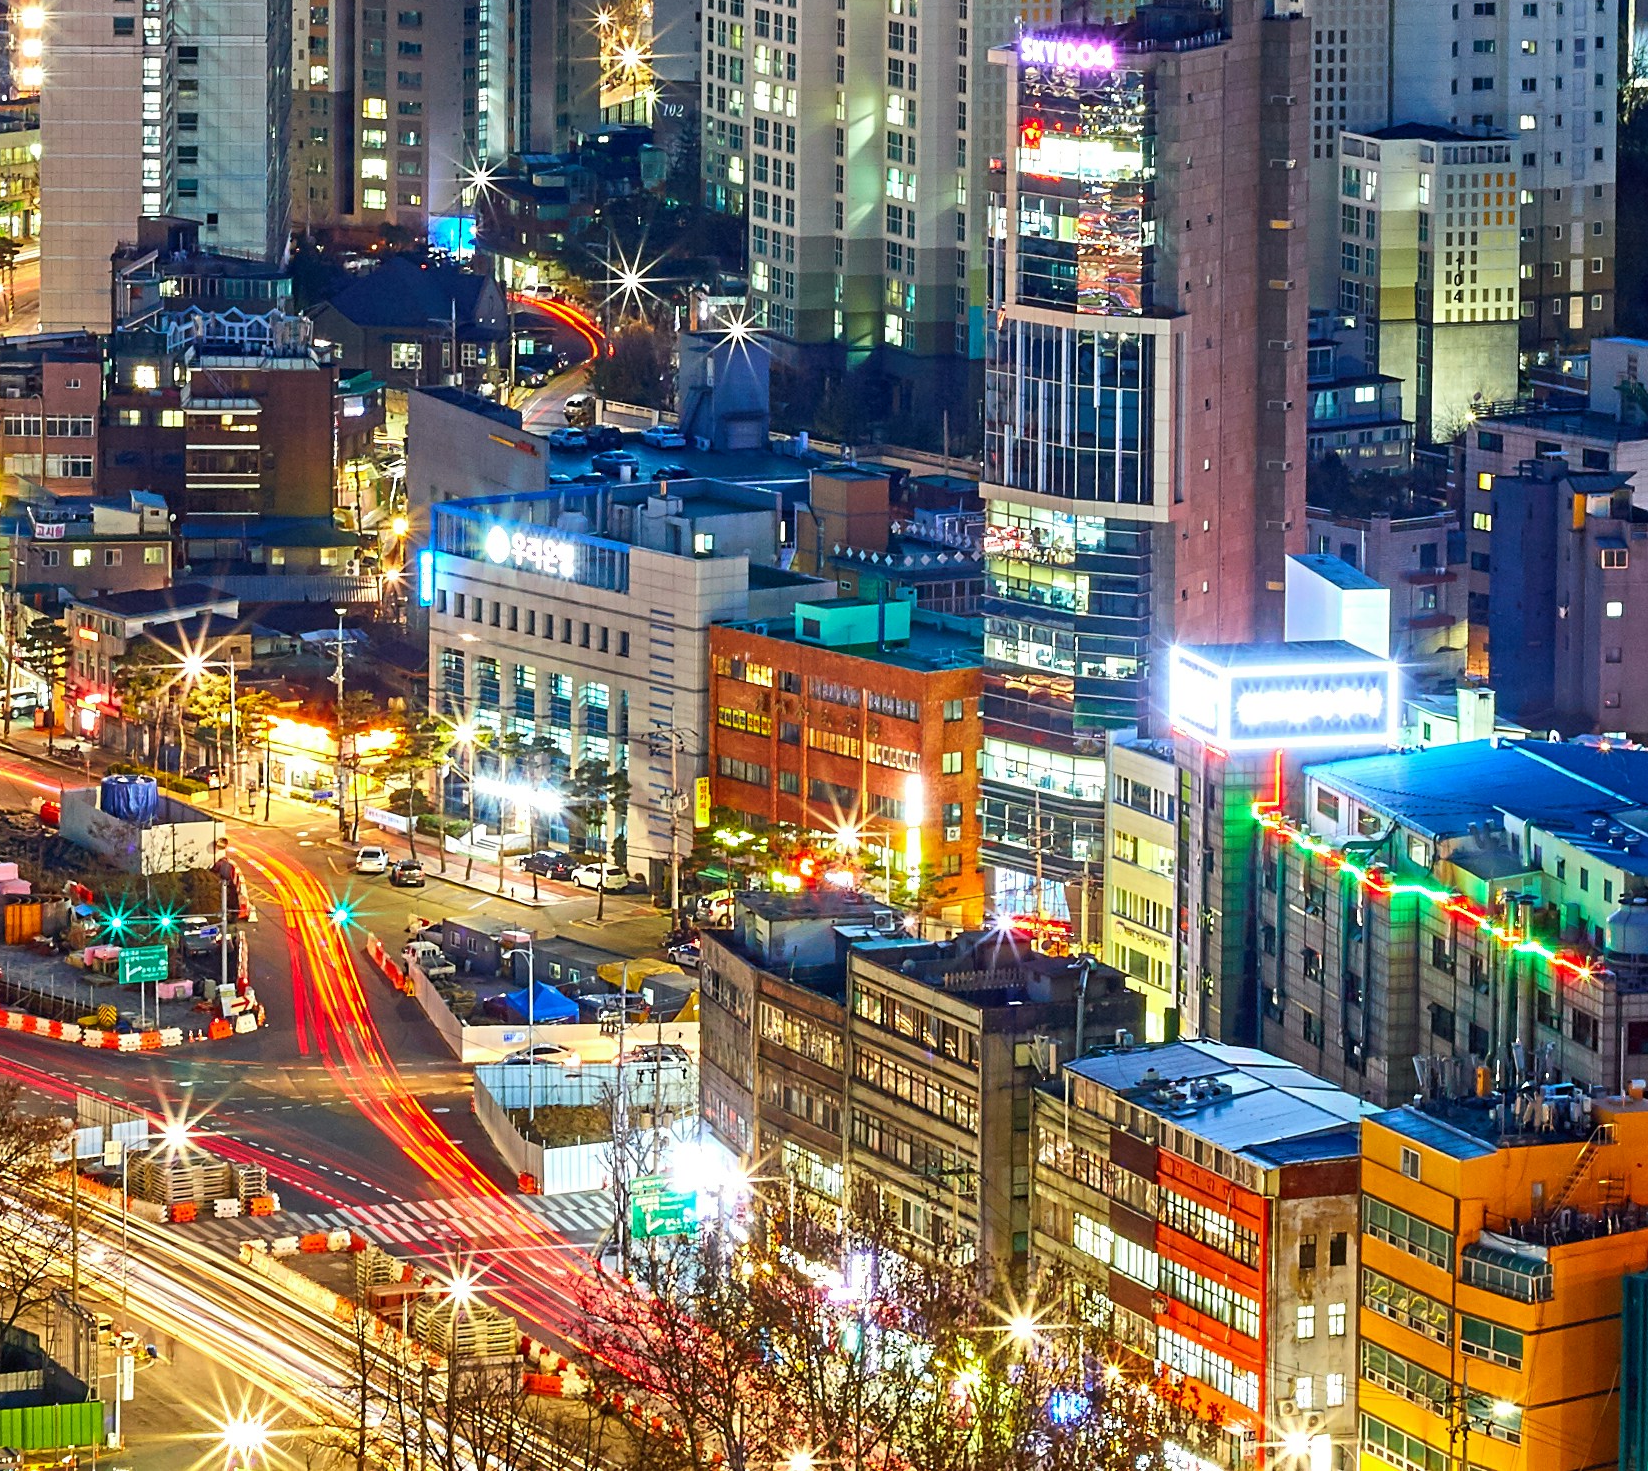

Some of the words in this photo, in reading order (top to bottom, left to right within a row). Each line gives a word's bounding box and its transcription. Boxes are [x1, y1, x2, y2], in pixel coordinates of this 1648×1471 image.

[1021, 37, 1115, 69] SKY1004
[663, 103, 684, 118] 102
[1454, 257, 1463, 303] 104
